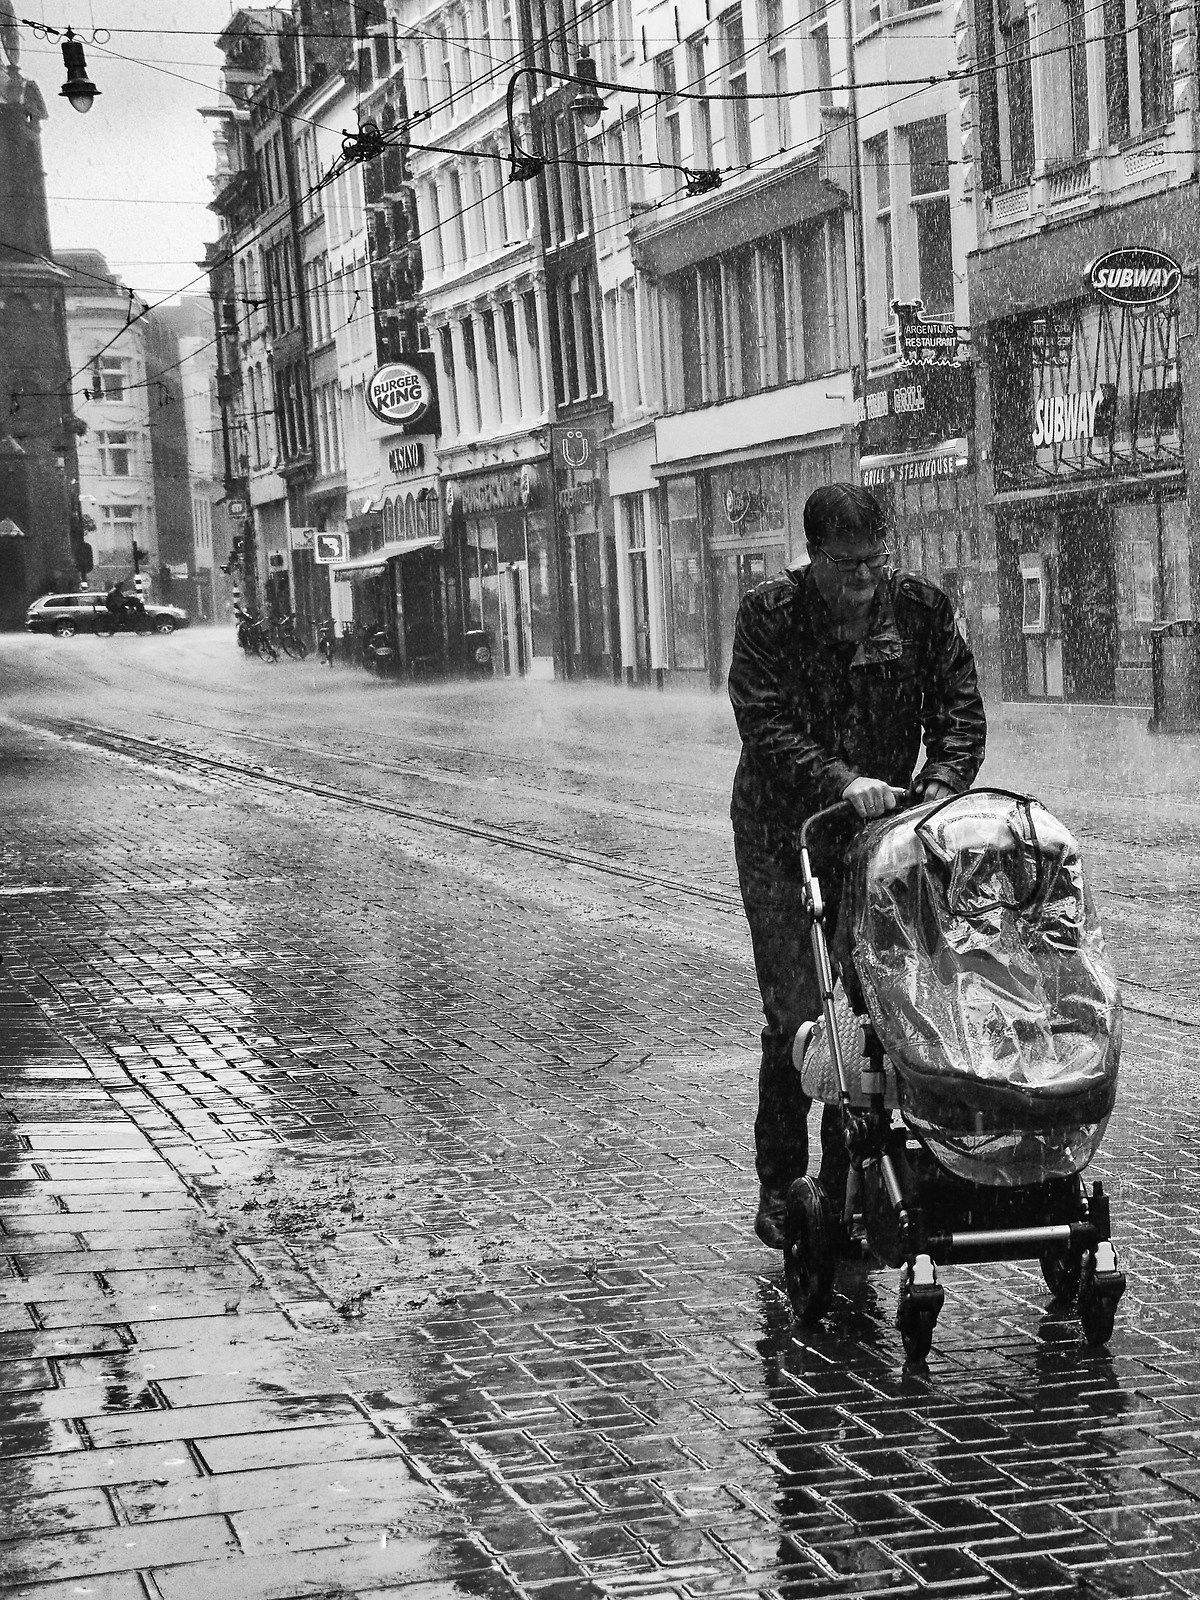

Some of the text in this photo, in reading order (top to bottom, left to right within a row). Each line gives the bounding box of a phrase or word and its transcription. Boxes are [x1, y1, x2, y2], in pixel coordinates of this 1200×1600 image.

[1093, 268, 1180, 288] SUBWAY
[905, 337, 956, 347] RESTAURANT
[374, 375, 419, 397] BURGER
[377, 385, 422, 412] KING
[1032, 386, 1104, 446] SUBWAY
[864, 469, 885, 486] GRILL
[899, 457, 954, 481] STEAKHOUSE
